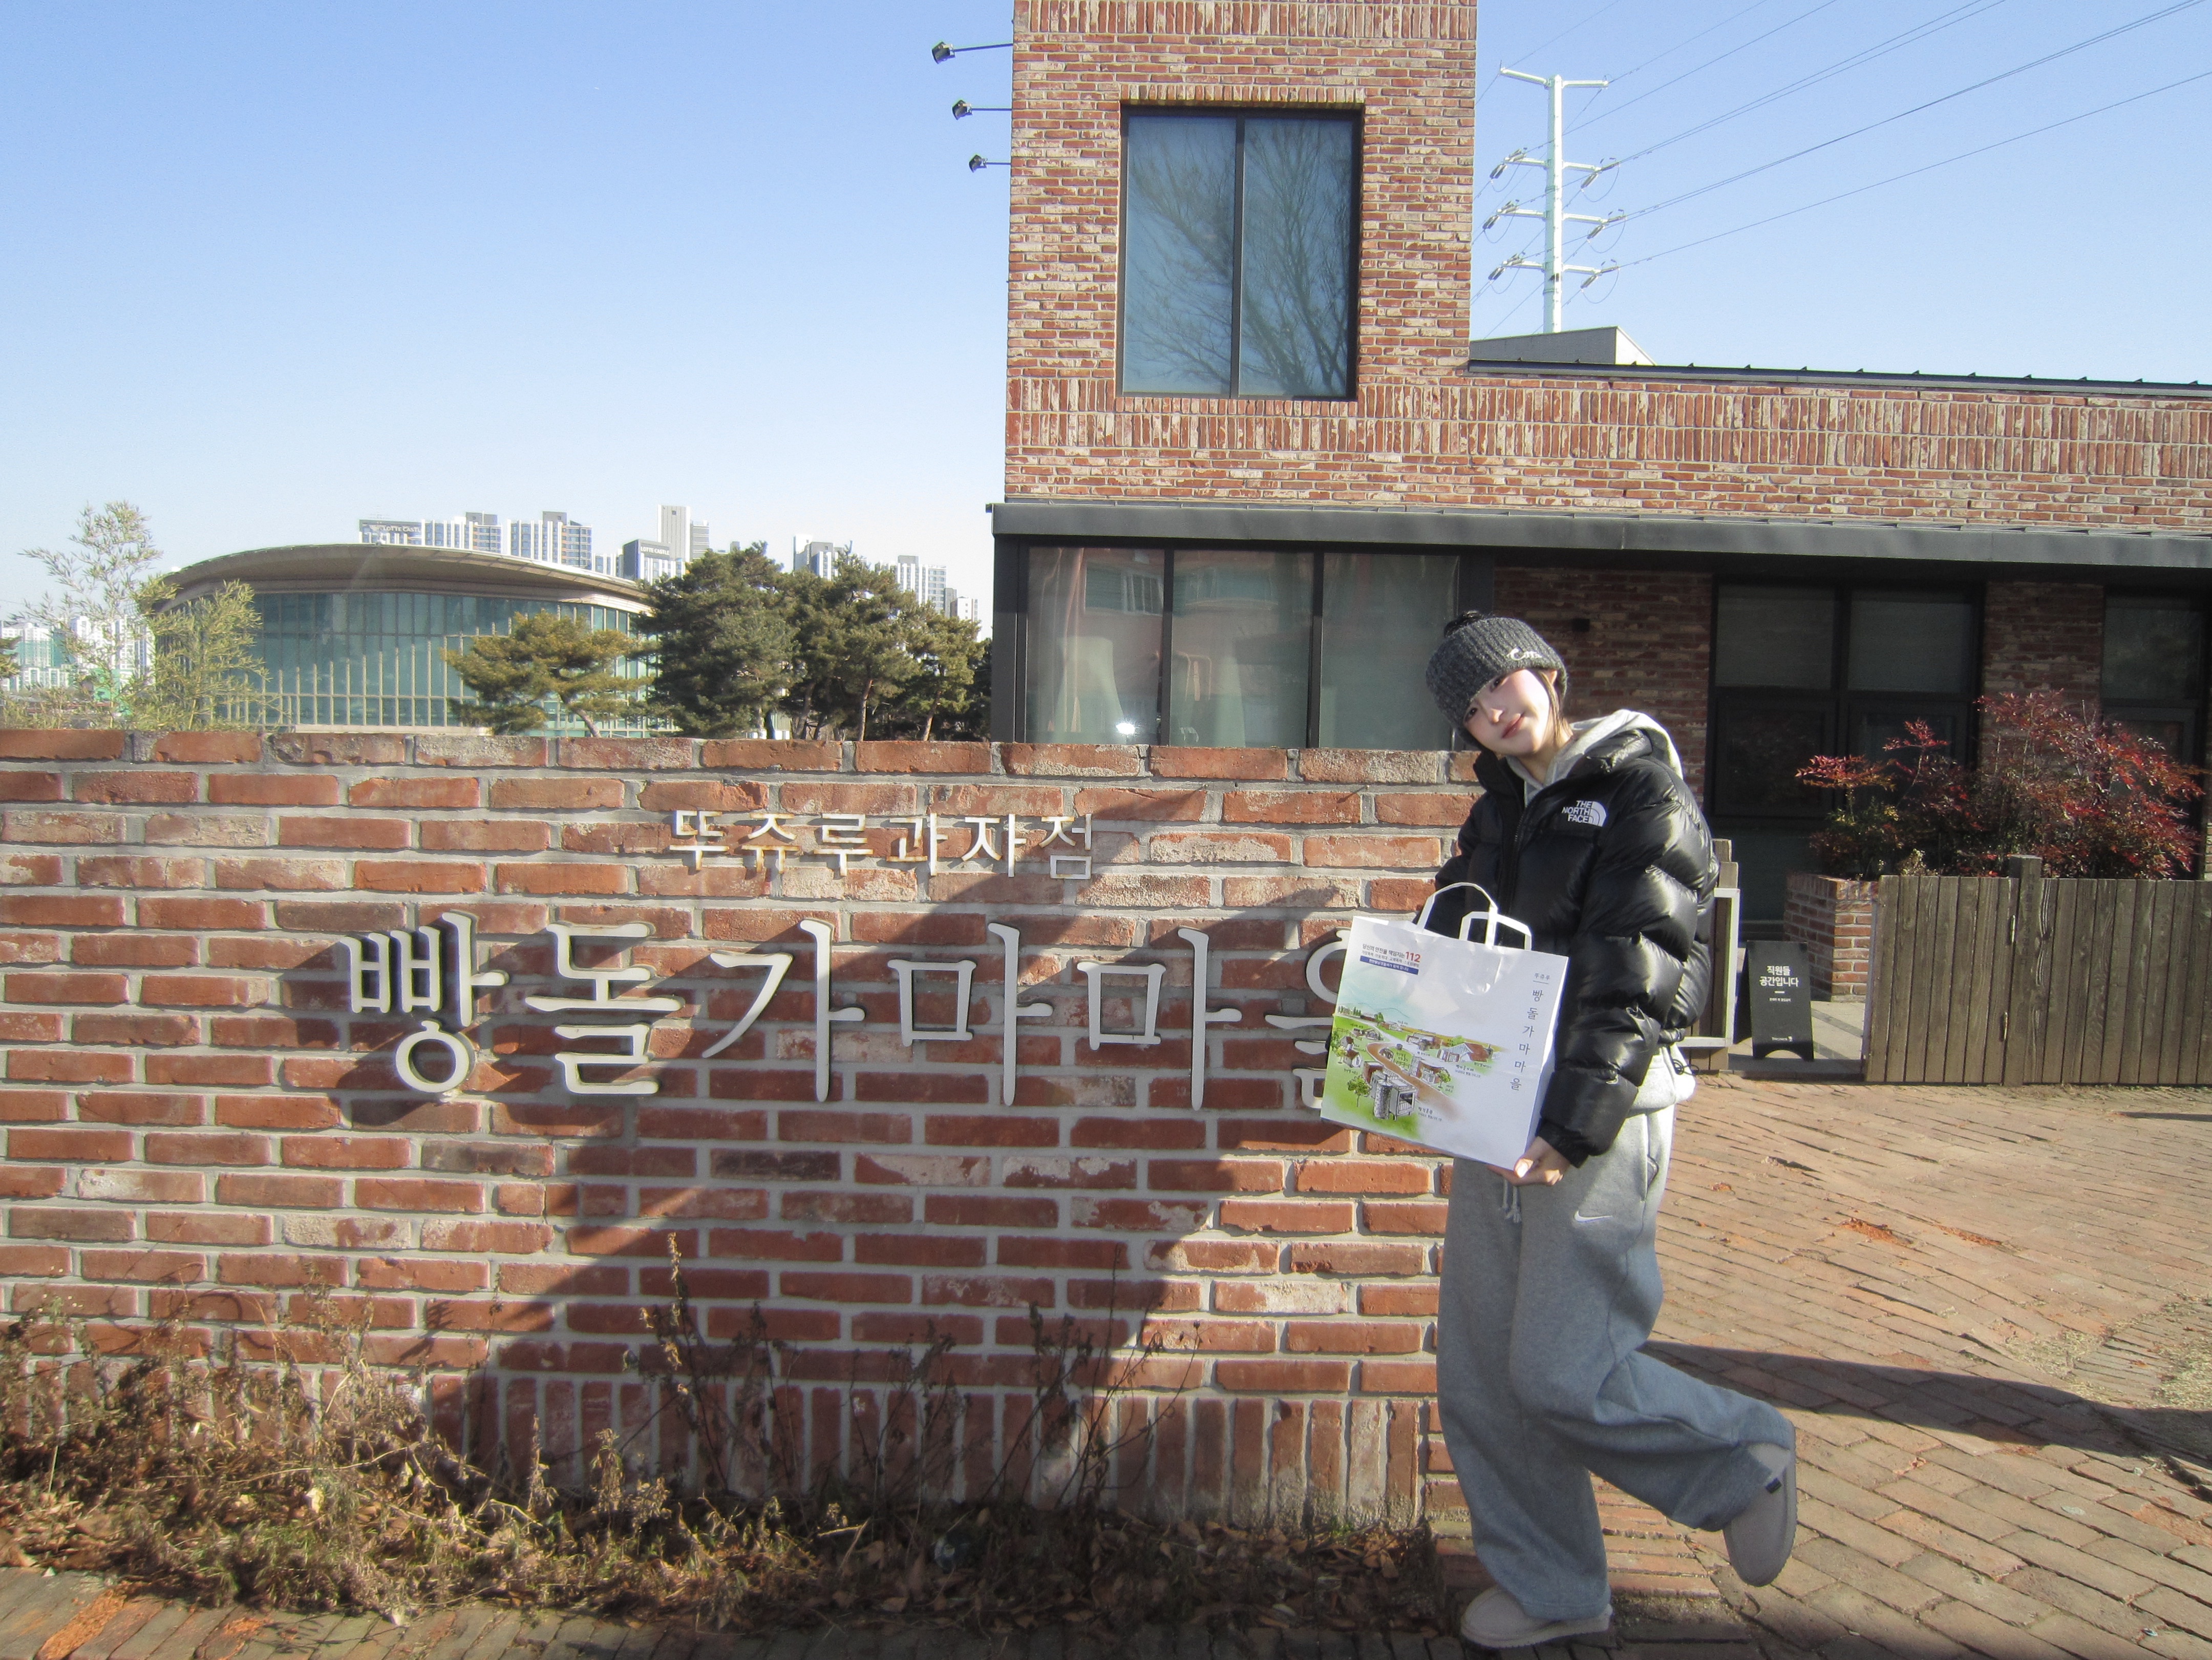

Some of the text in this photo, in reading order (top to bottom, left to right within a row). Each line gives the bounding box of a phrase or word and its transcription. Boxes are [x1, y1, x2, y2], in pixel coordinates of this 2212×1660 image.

[1576, 800, 1592, 808] THE
[1561, 807, 1590, 815] NORTH
[1567, 814, 1589, 823] FACE
[669, 810, 1093, 880] 뚜쥬루과자점
[1363, 943, 1375, 952] 당신의
[1406, 951, 1421, 962] 112
[1767, 965, 1791, 976] 직원들
[1534, 973, 1550, 981] 뚜쥬루
[1759, 976, 1799, 987] 공간입니다
[1509, 990, 1544, 1091] 빵돌가마마을
